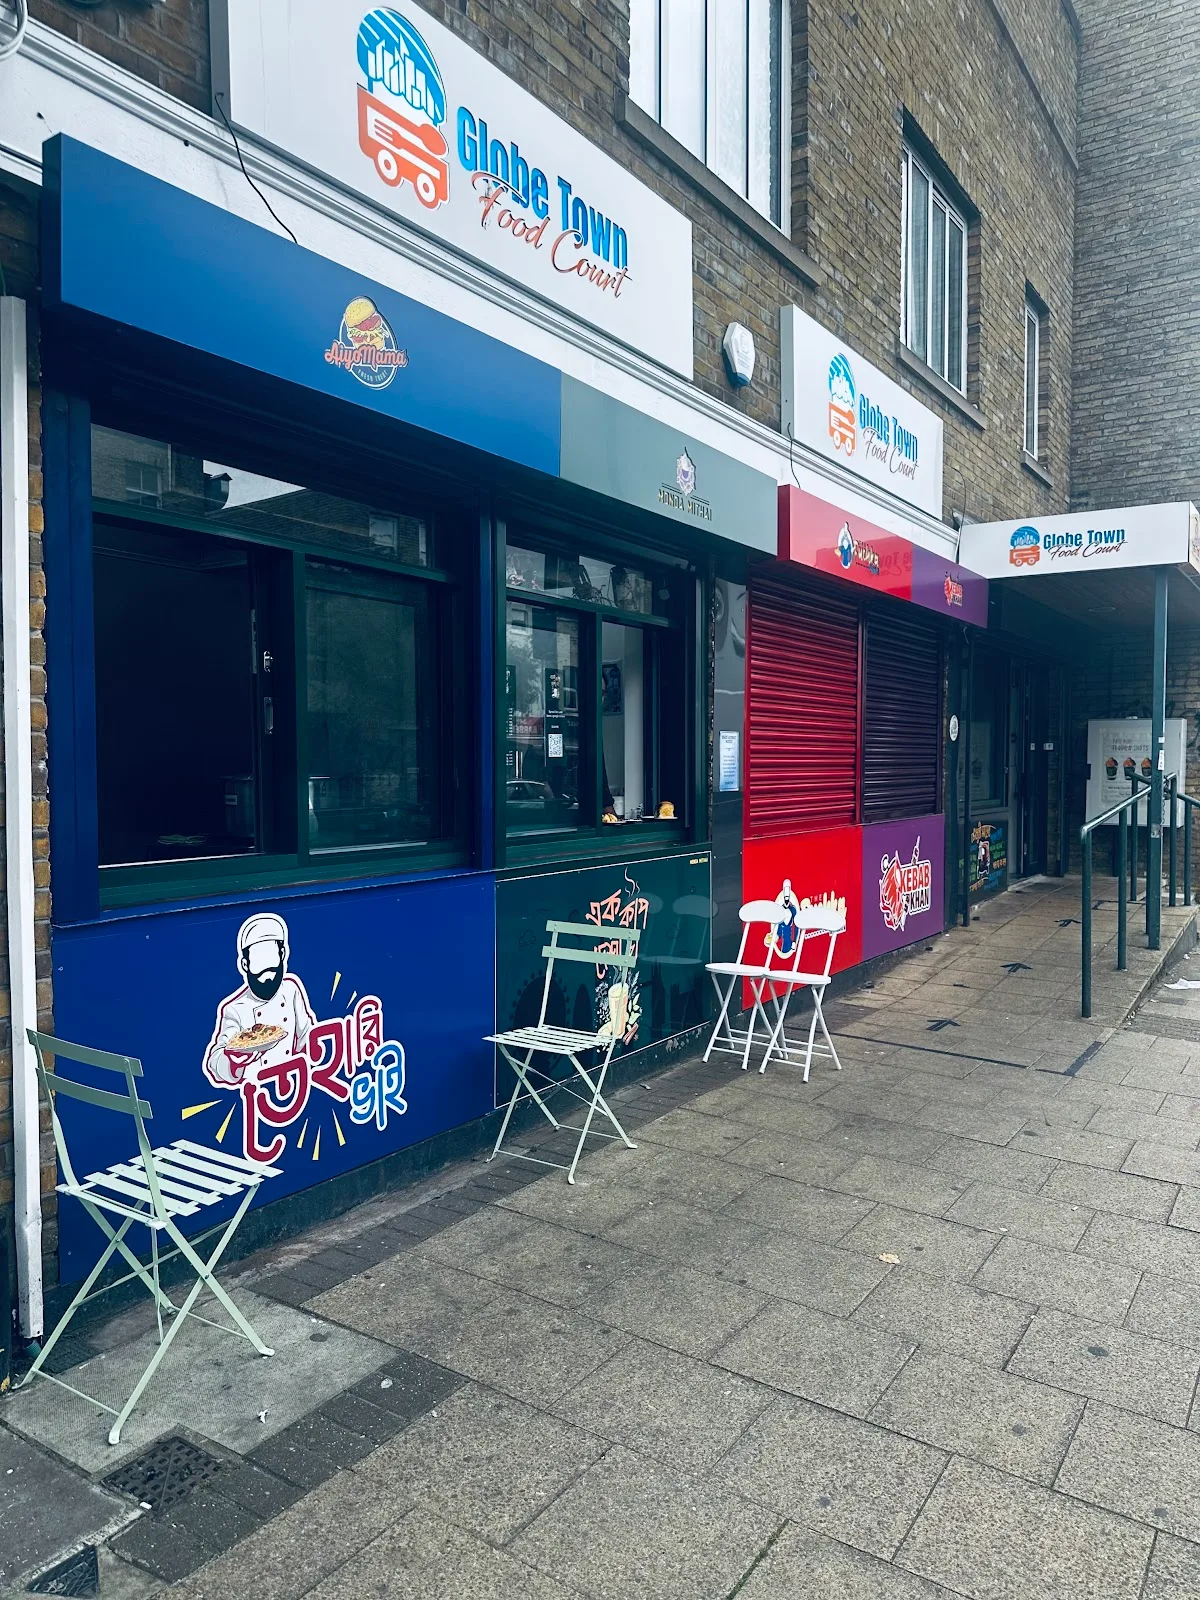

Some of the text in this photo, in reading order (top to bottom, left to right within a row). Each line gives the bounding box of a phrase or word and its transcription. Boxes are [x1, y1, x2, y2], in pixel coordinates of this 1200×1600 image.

[457, 106, 629, 269] Globe Town
[471, 172, 633, 298] Food Court
[859, 393, 918, 462] Globe Town
[863, 427, 919, 480] Food Court
[658, 489, 712, 521] MONDA MITHAI
[1043, 528, 1126, 550] Globe Town
[1048, 540, 1128, 561] Food Court
[899, 864, 930, 893] KEBAB
[810, 893, 823, 902] THE
[910, 888, 929, 910] KHAN
[243, 997, 406, 1163] তেহারি ভাই
